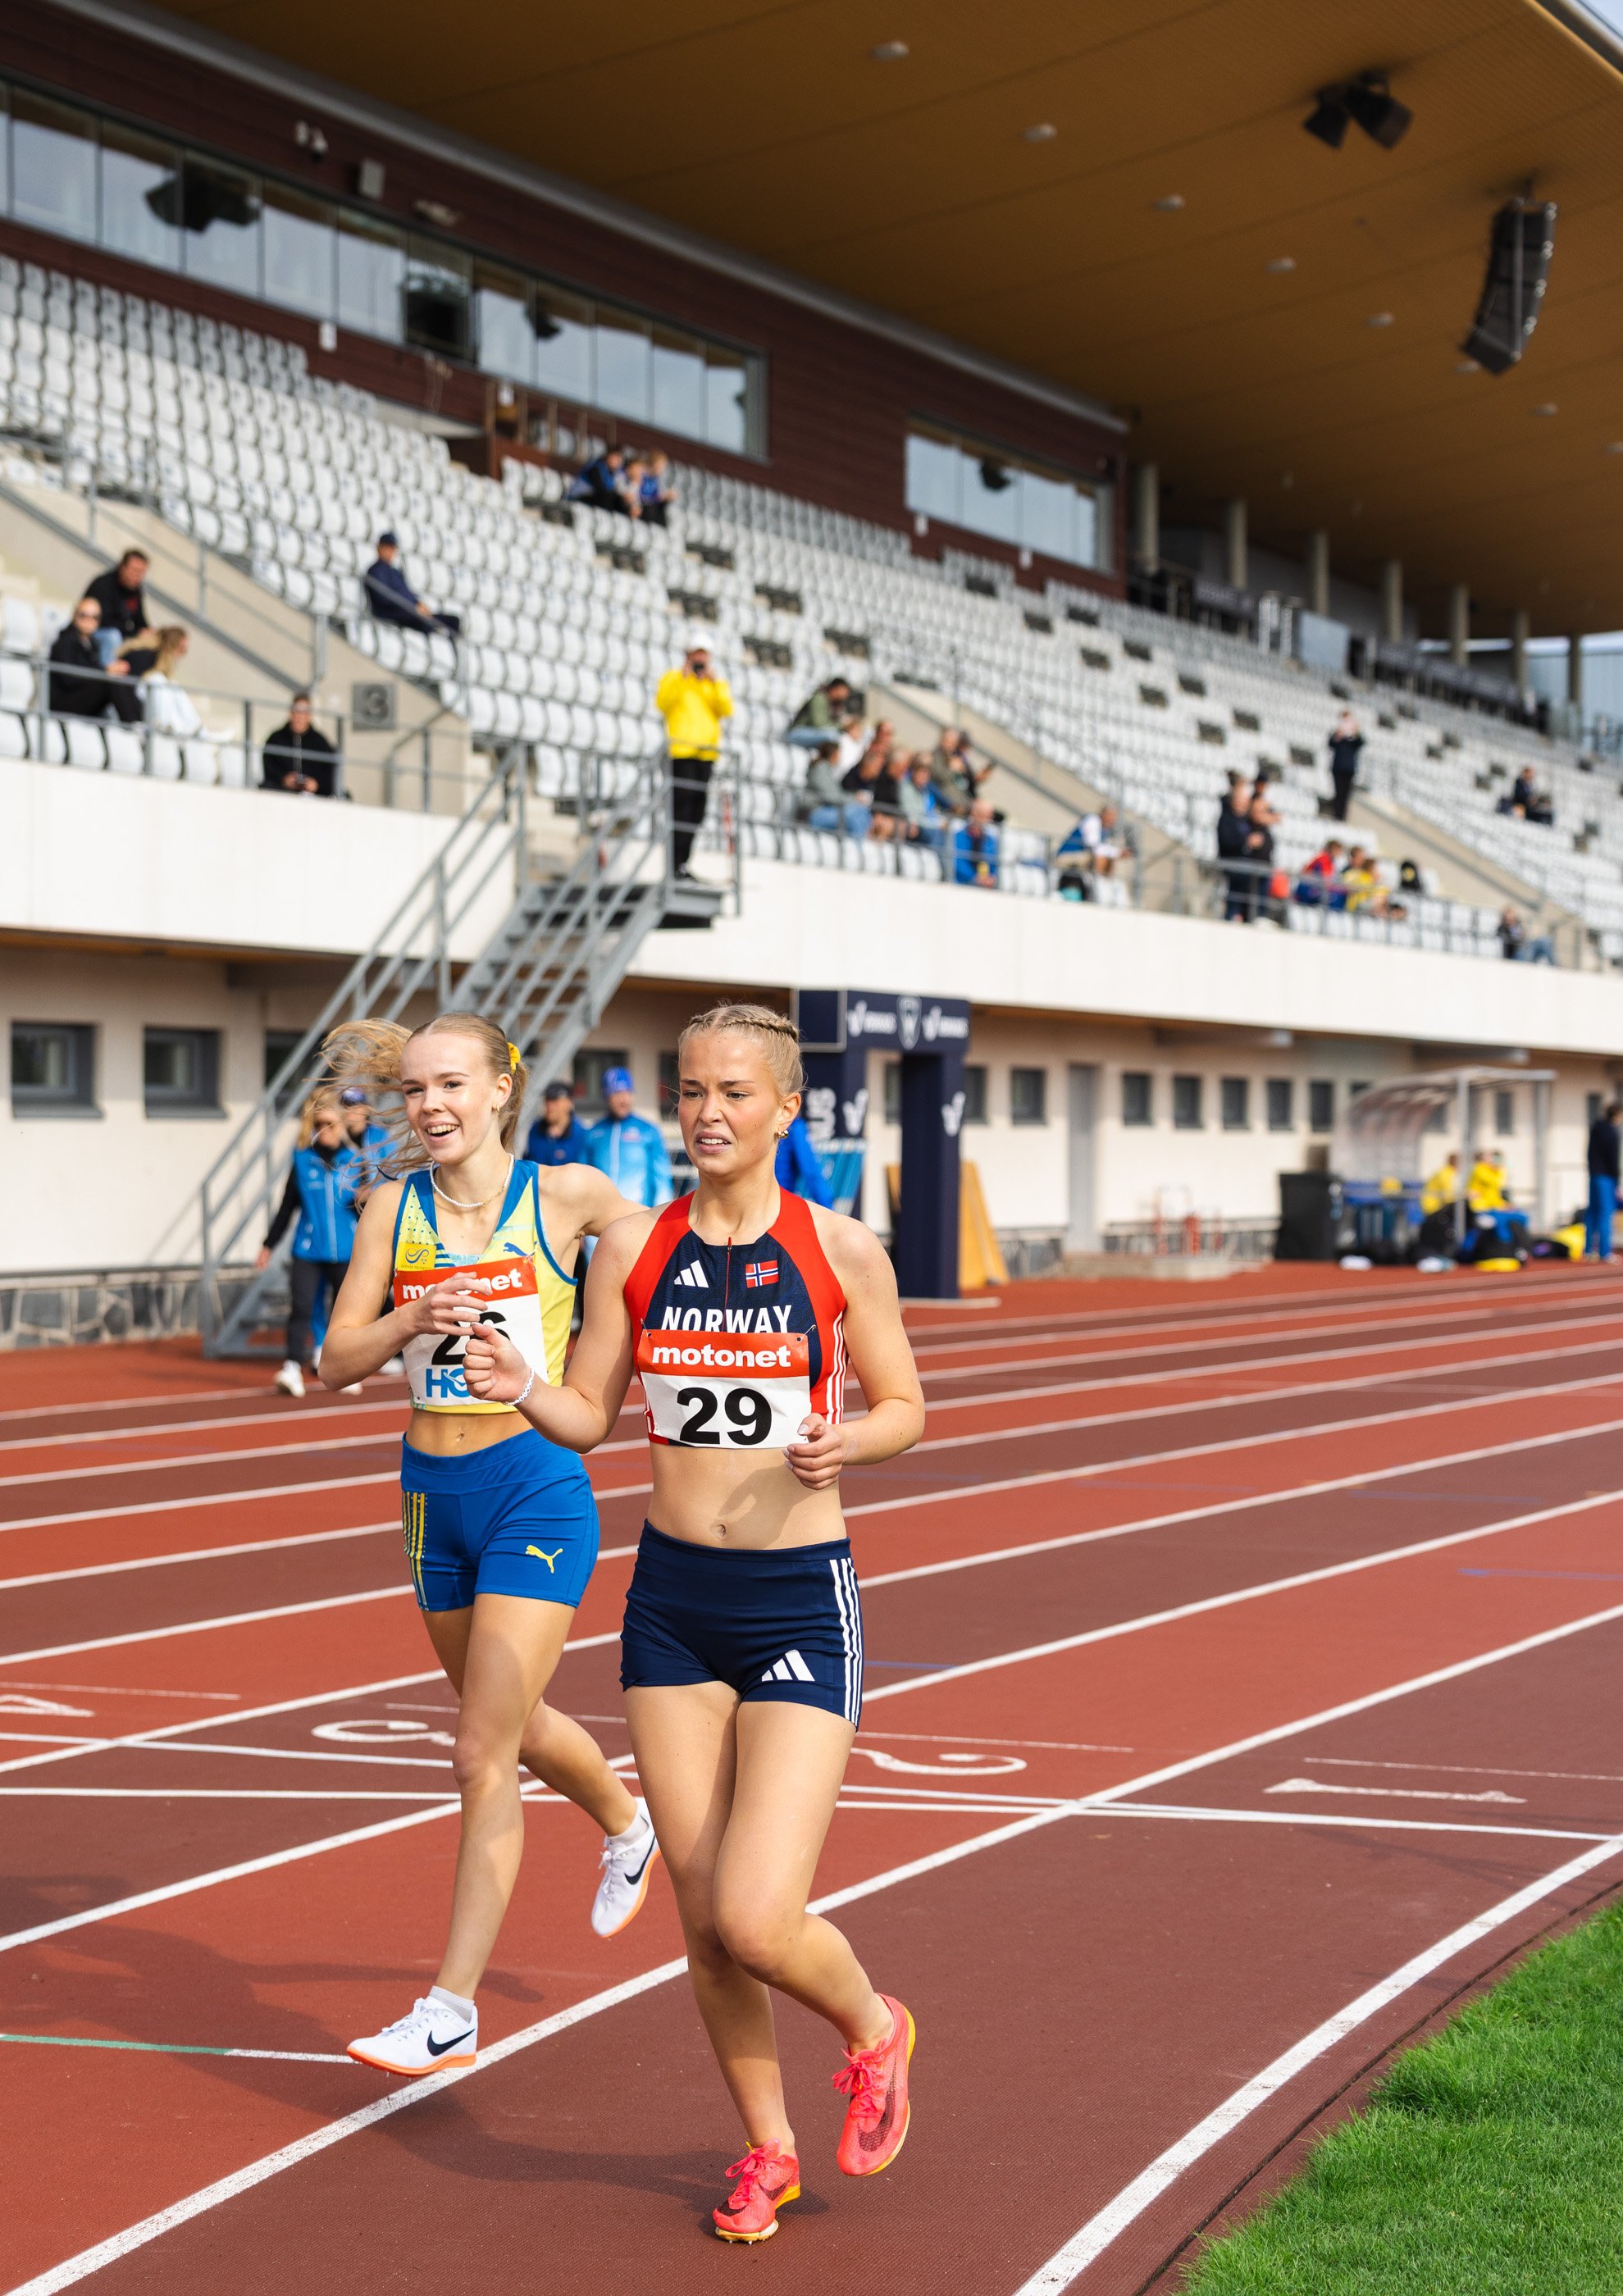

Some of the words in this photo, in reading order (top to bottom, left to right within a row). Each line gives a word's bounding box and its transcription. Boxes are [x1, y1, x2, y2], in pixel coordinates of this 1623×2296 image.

[402, 1268, 523, 1299] mnet
[660, 1305, 792, 1333] NORWAY
[652, 1344, 791, 1367] motonet
[677, 1387, 772, 1445] 29
